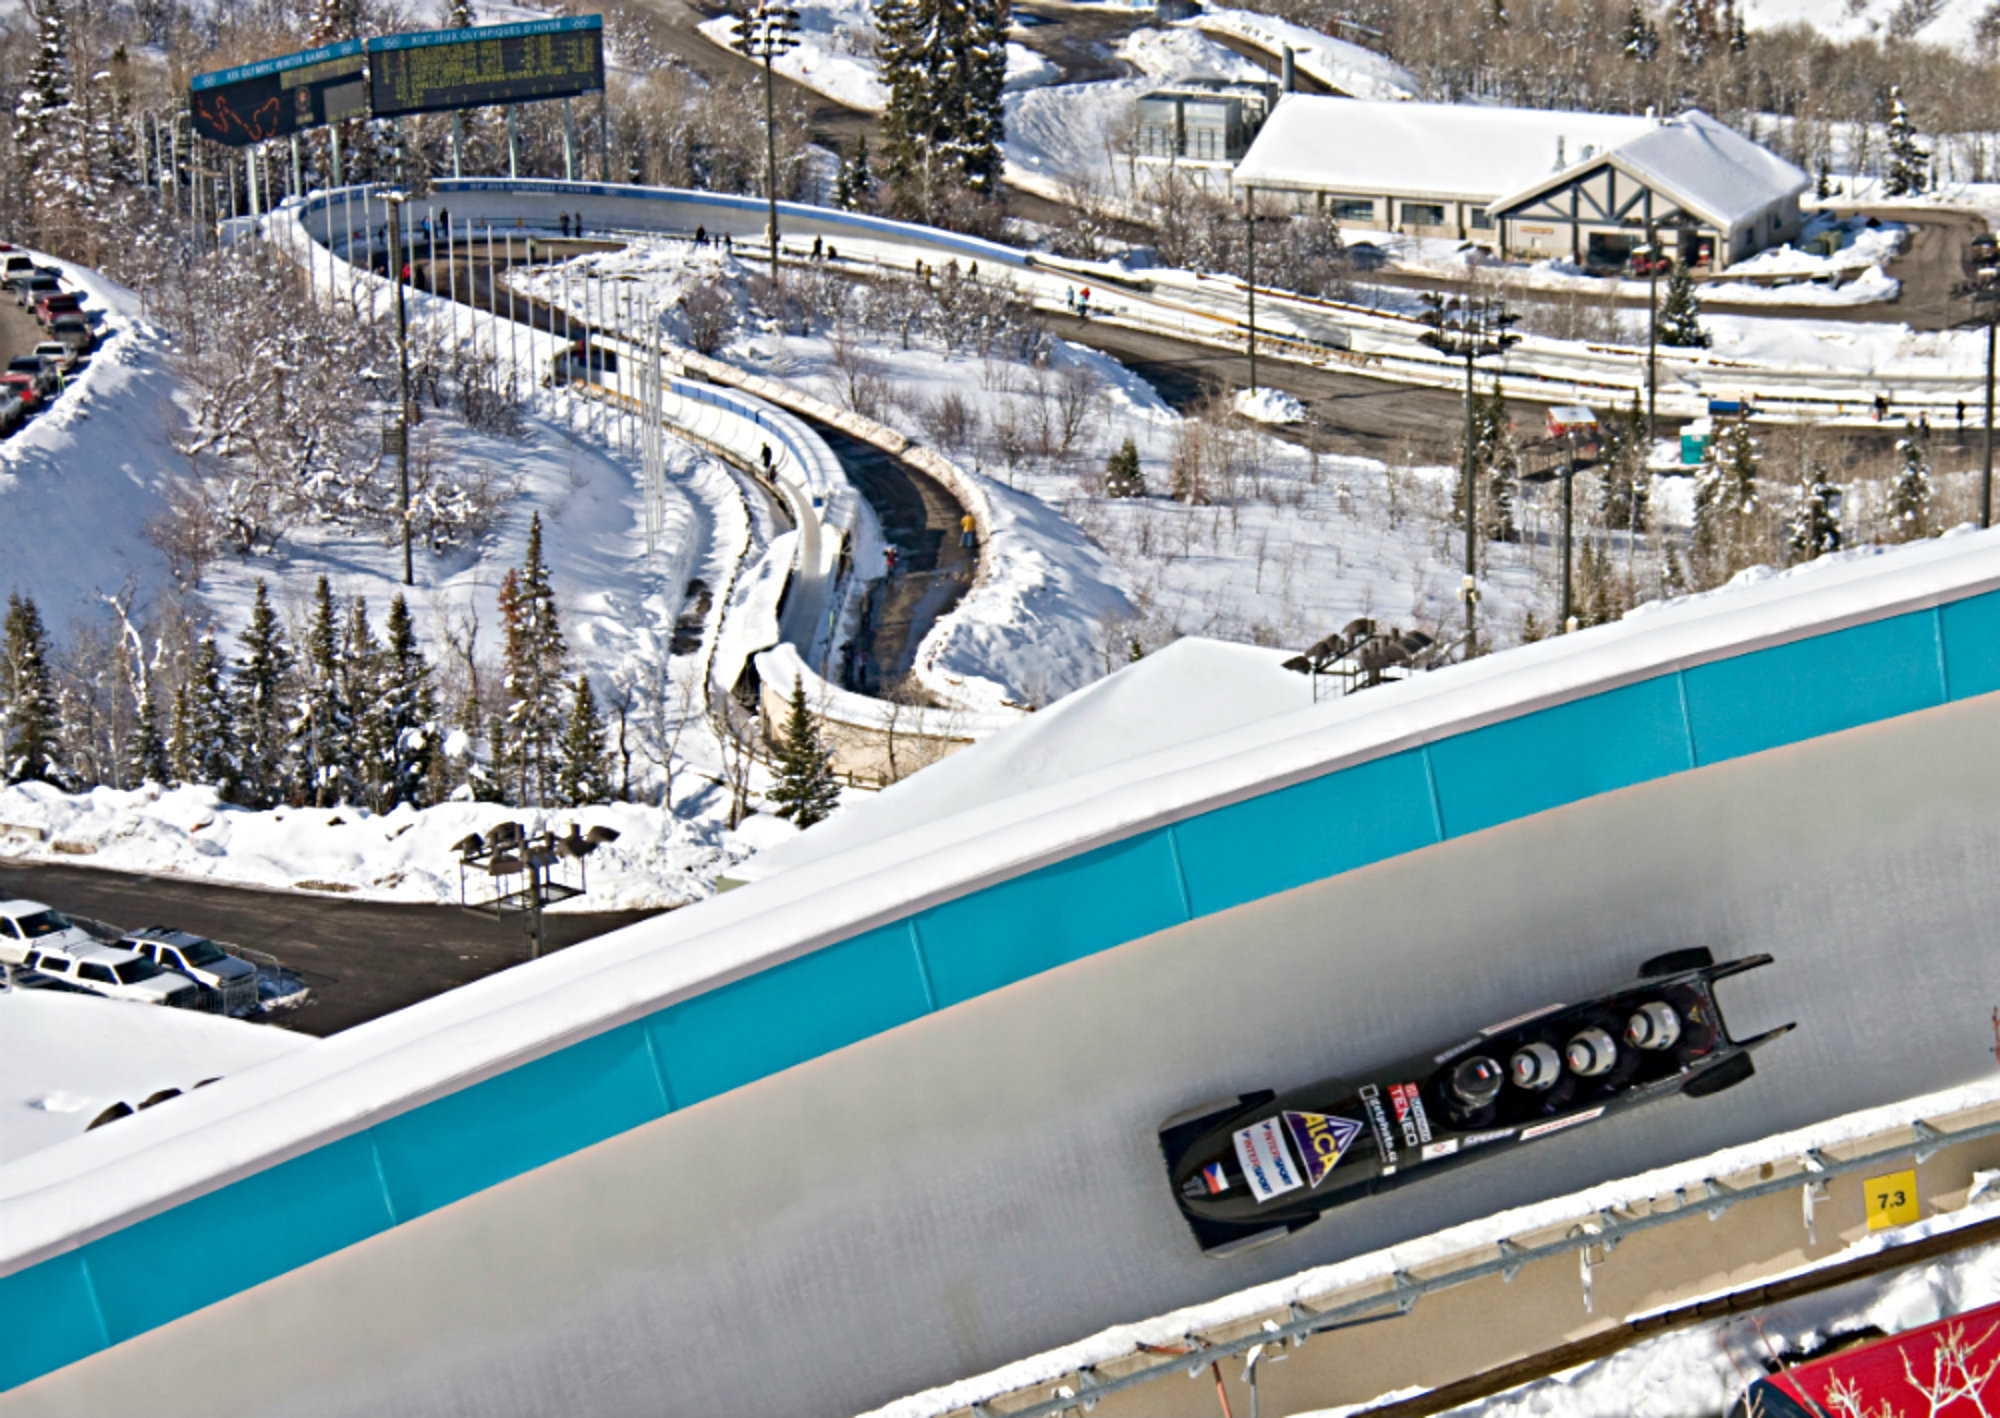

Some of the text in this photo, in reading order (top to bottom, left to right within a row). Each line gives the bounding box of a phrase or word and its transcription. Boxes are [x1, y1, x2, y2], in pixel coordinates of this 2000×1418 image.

[435, 31, 457, 43] JEUX
[460, 25, 521, 39] OLYMPIQUES
[242, 62, 274, 78] OLYMPIC
[275, 56, 303, 70] WINTER
[305, 50, 330, 62] GAMES
[1263, 1129, 1293, 1185] INTERSPORT
[1300, 1112, 1340, 1173] ALCA
[1243, 1137, 1272, 1193] INTERSPORT
[1877, 1190, 1906, 1210] 7.3
